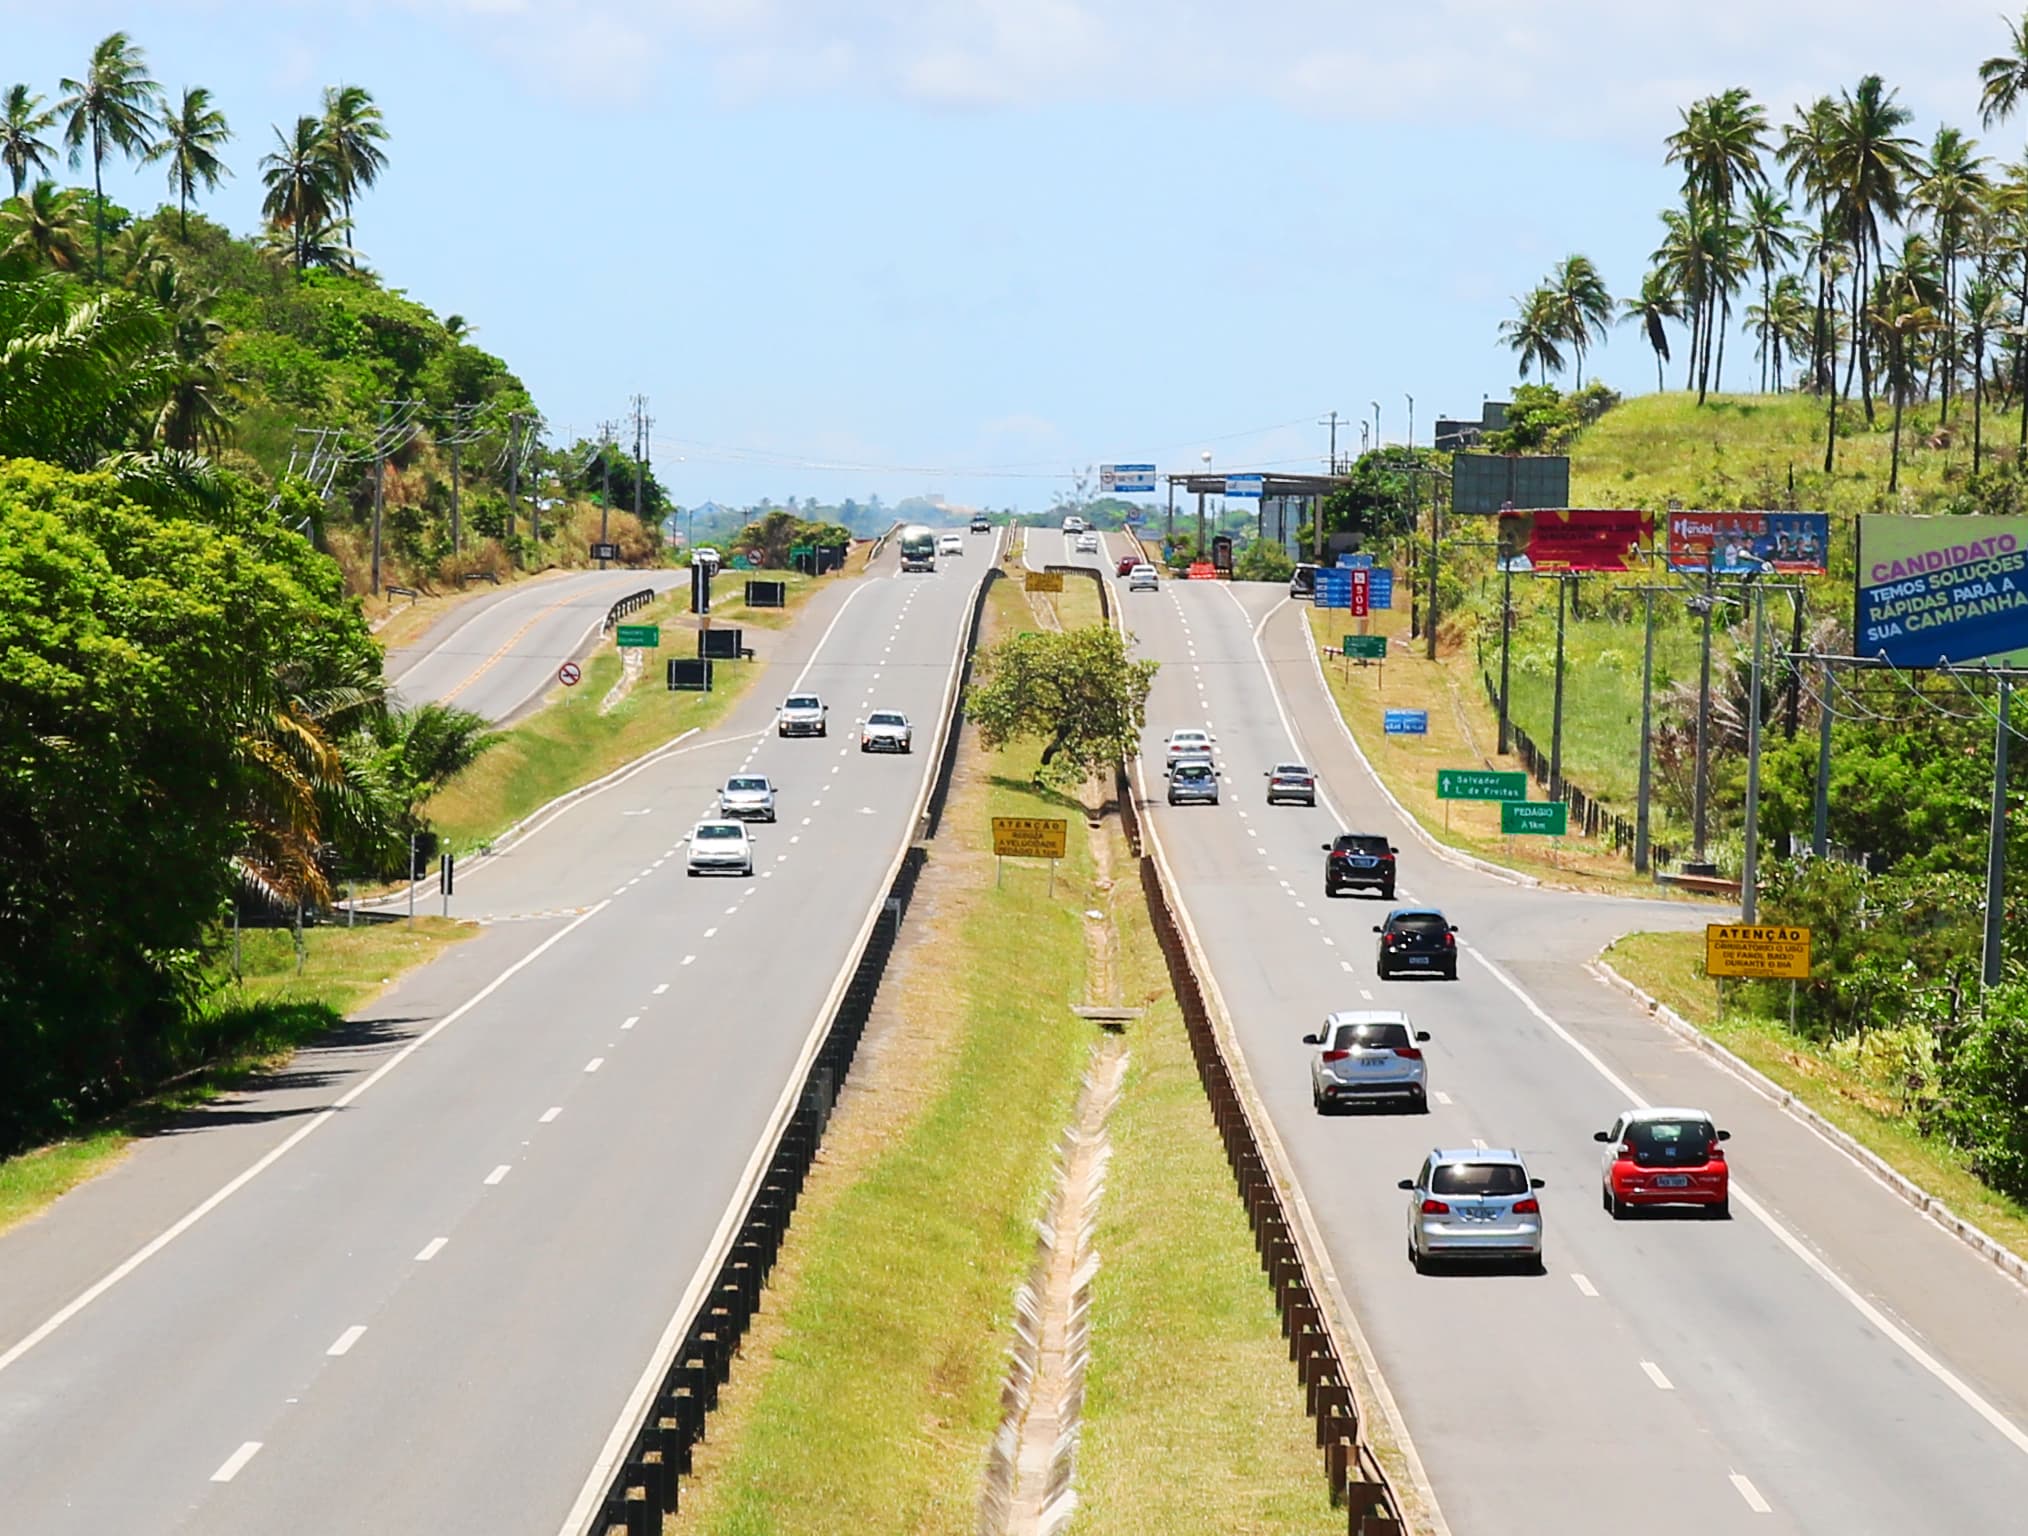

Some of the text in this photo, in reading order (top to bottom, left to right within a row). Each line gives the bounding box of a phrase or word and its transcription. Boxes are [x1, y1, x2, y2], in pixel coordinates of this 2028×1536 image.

[1871, 533, 2017, 583] CANDIDATO
[1870, 554, 2025, 603] TEMOS SOLUÇÕES
[1869, 577, 2015, 622] RÁPIDAS PARA A
[1867, 591, 2028, 641] SUA CAMPANHA
[1456, 775, 1500, 785] Salvador
[1483, 787, 1520, 797] Freitas
[998, 820, 1060, 831] ATENÇÃO
[1719, 928, 1800, 942] ATENÇÃO
